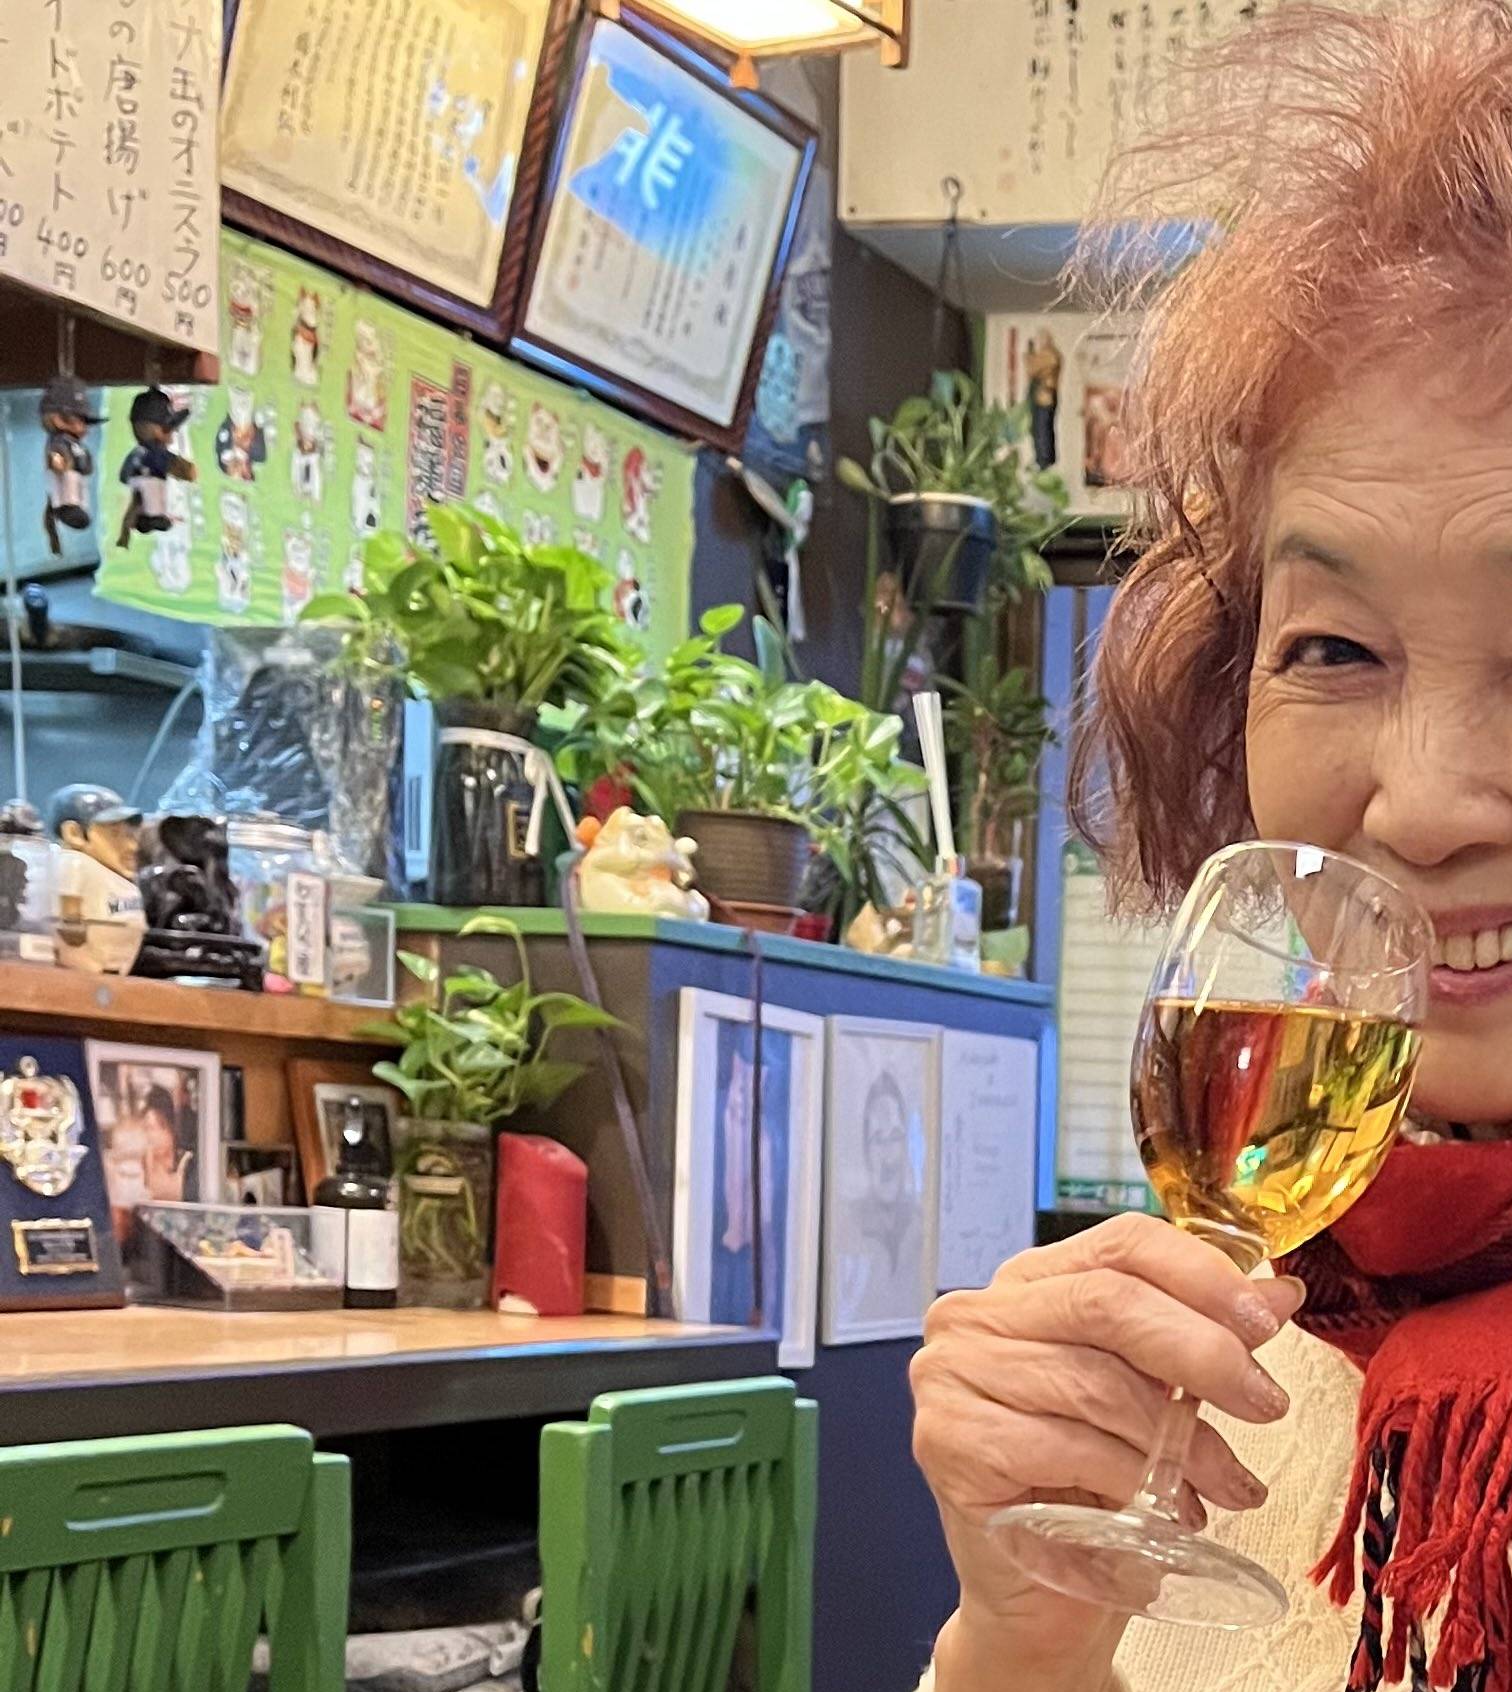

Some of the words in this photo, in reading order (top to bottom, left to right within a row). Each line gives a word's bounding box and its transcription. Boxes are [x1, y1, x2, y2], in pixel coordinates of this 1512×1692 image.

[37, 216, 89, 258] 400
[100, 245, 151, 288] 600
[161, 272, 212, 309] 500
